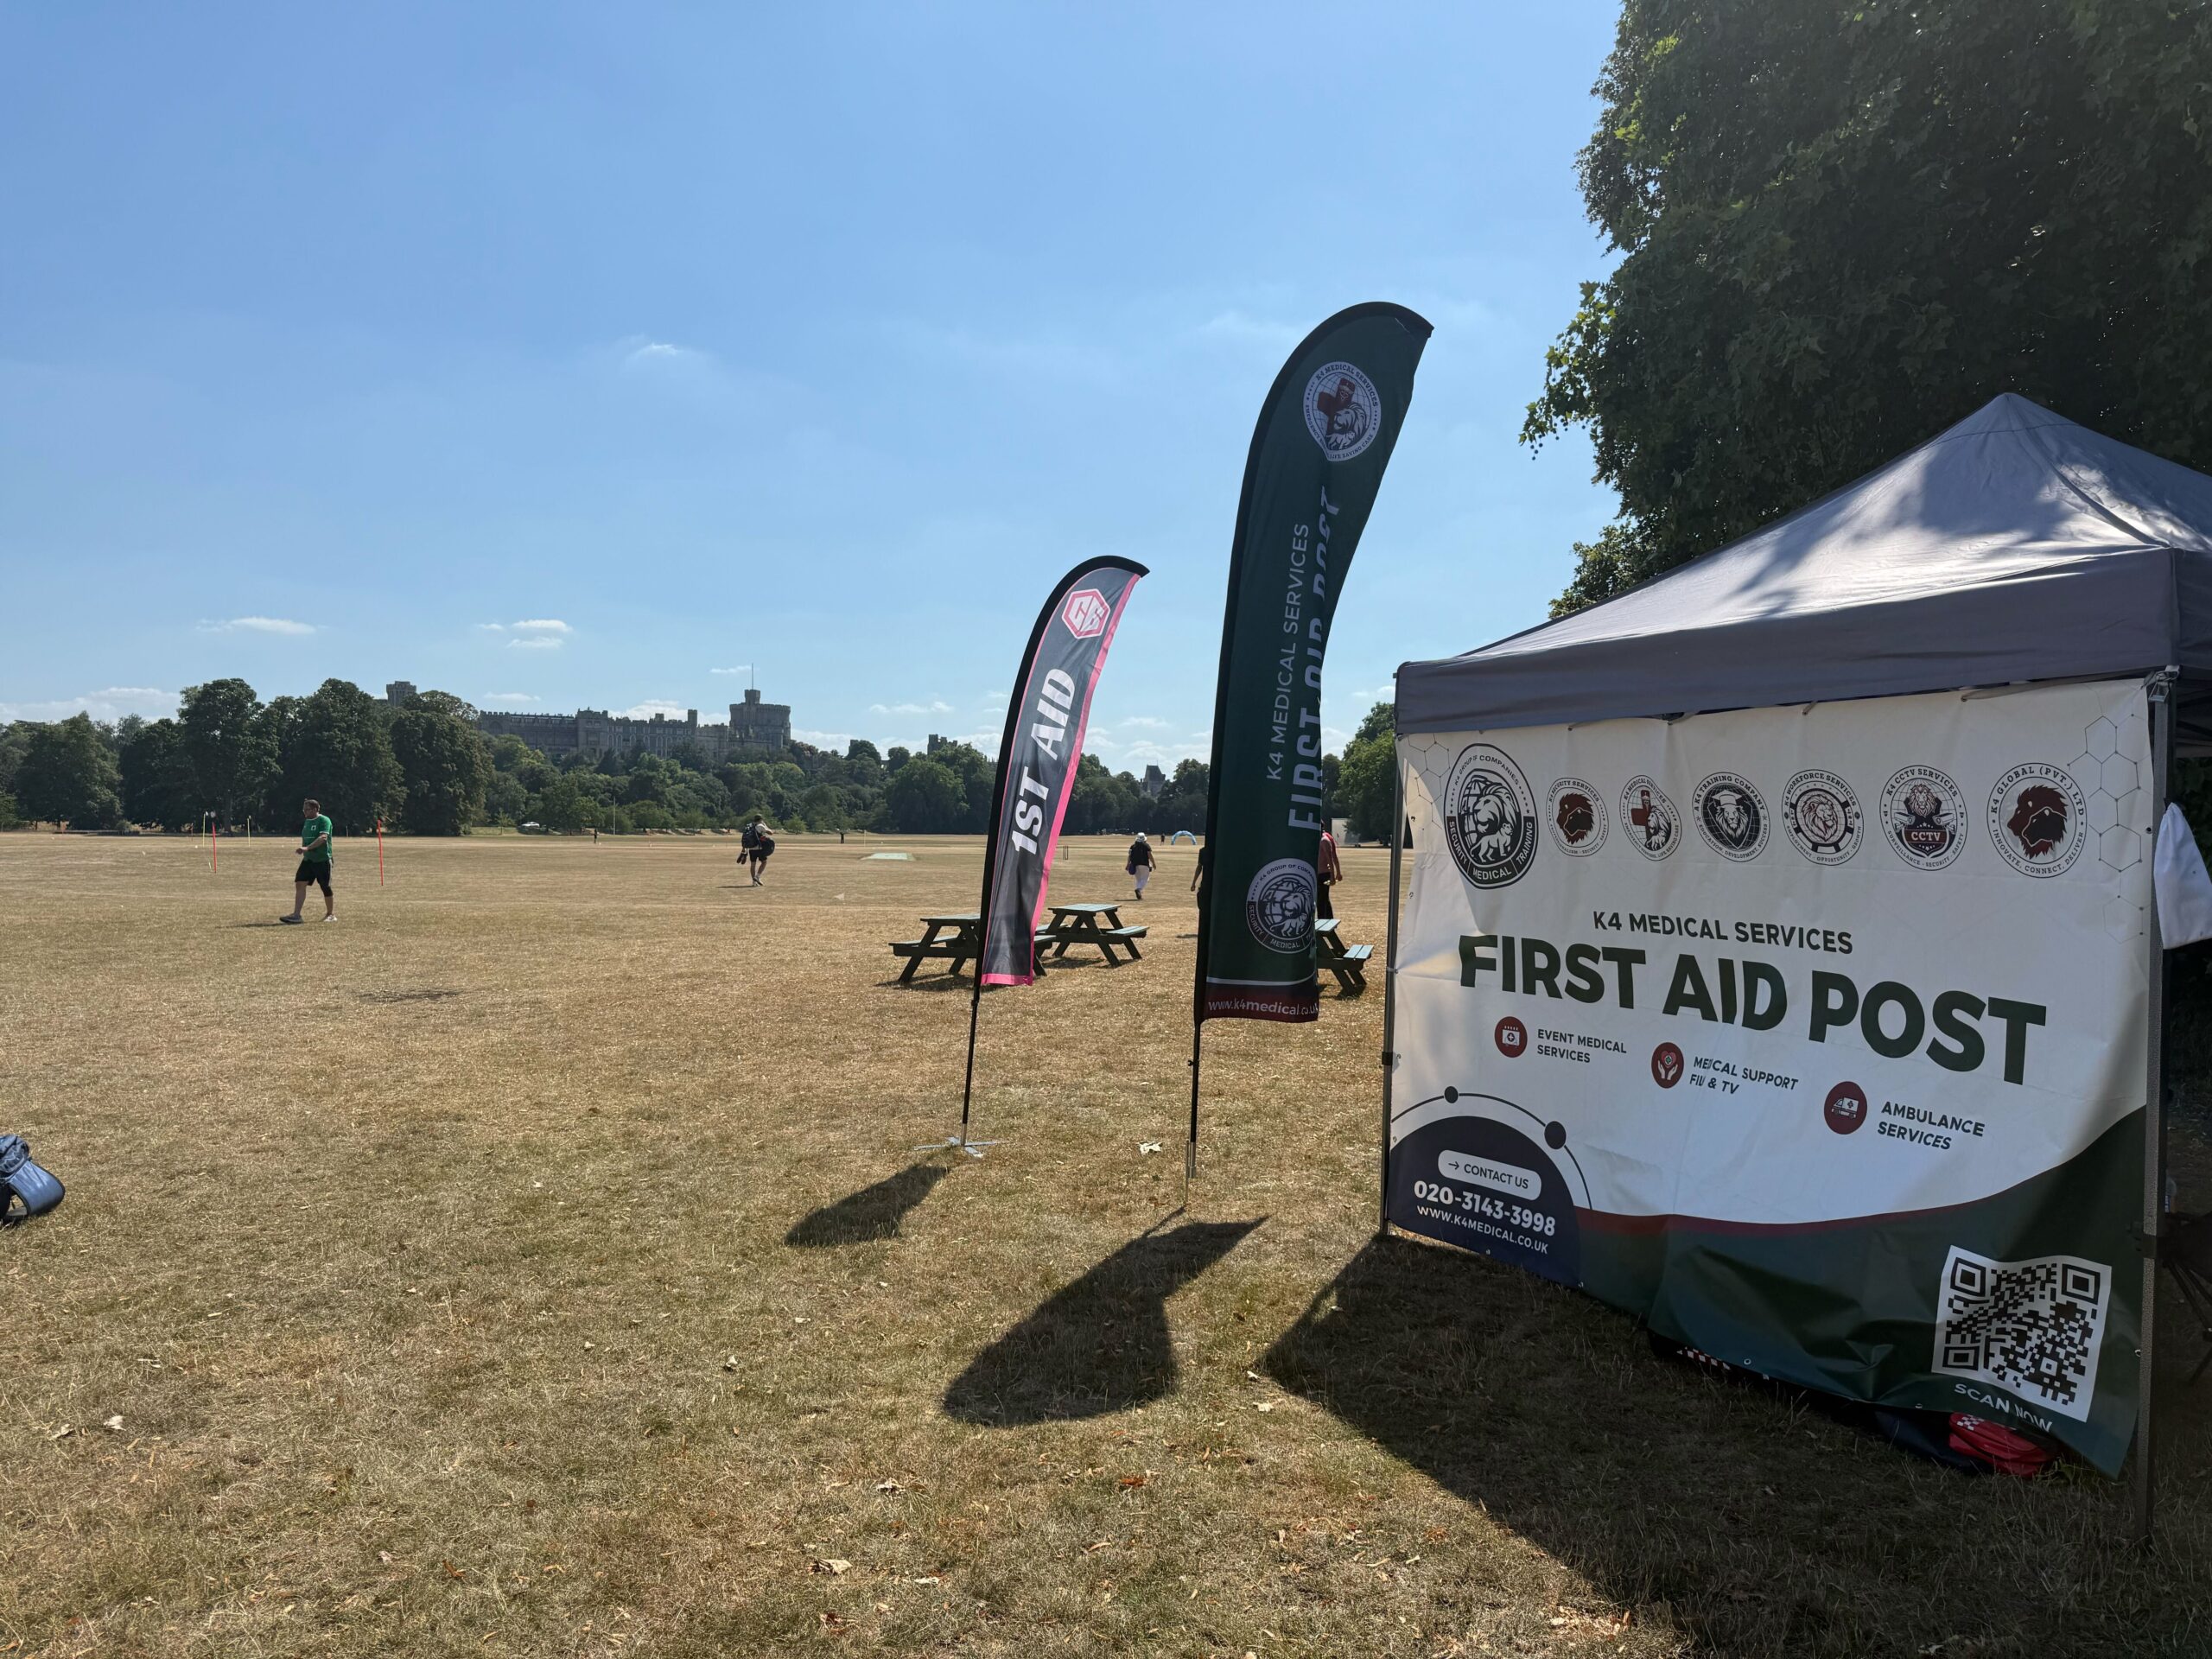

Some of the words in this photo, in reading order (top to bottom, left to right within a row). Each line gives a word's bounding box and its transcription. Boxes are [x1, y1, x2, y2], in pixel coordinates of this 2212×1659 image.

[1325, 364, 1355, 374] MEDICAL
[1356, 372, 1379, 407] SERVICES
[1283, 524, 1308, 634] SERVICES
[1271, 643, 1295, 744] MEDICAL
[1011, 766, 1049, 855] 1ST
[1030, 668, 1075, 760] AID
[1267, 751, 1284, 780] K4
[1479, 755, 1519, 785] COMPANIES
[1573, 780, 1599, 802] SERVICES
[1624, 791, 1630, 800] K4
[1628, 778, 1646, 792] MEDICAL
[1694, 793, 1701, 804] K4
[1700, 775, 1732, 792] TRAINING
[1734, 778, 1765, 810] COMPANY
[1784, 796, 1789, 806] K4
[1787, 772, 1824, 794] WORKFORCE
[1826, 775, 1856, 806] SERVICES
[1886, 784, 1896, 796] K4
[1894, 769, 1916, 784] CCTV
[1917, 768, 1958, 797] SERVICES
[1991, 798, 1999, 814] K4
[1997, 766, 2035, 794] GLOBAL
[2039, 766, 2073, 790] (PVT.)
[2072, 791, 2084, 816] LTD
[1449, 821, 1468, 864] SECURITY
[1516, 822, 1533, 865] TRAINING
[1888, 830, 1921, 865] SURVEILLANCE
[1925, 856, 1950, 867] SECURITY
[1952, 834, 1964, 855] SAFETY
[1911, 831, 1941, 842] CCTV
[2065, 831, 2083, 865] DELIVER
[1267, 864, 1287, 875] GROUP
[1816, 850, 1850, 862] OPPORTUNITY
[1472, 867, 1512, 880] MEDICAL
[1249, 905, 1265, 937] SECURITY
[1593, 911, 1622, 931] K4
[1629, 913, 1728, 940] MEDICAL
[1734, 921, 1853, 955] SERVICES
[1270, 938, 1300, 949] MEDICAL
[1459, 935, 1646, 1009] FIRST
[1662, 954, 1788, 1031] AID
[1808, 969, 2046, 1085] POST
[1537, 1045, 1591, 1063] SERVICES
[1538, 1029, 1573, 1044] EVENT
[1578, 1035, 1627, 1053] MEDICAL
[1708, 1077, 1717, 1090] &
[1721, 1080, 1740, 1095] TV
[1742, 1067, 1799, 1090] SUPPORT
[1881, 1101, 1986, 1137] AMBULANCE
[1877, 1122, 1952, 1150] SERVICES
[1464, 1163, 1513, 1185] CONTACT
[1515, 1177, 1529, 1190] US
[1414, 1180, 1556, 1236] 020-3143-3998
[1417, 1205, 1548, 1255] WWW.K4MEDICAL.CO.UK
[1954, 1383, 2010, 1414] SCAN
[2014, 1403, 2053, 1433] NOW
